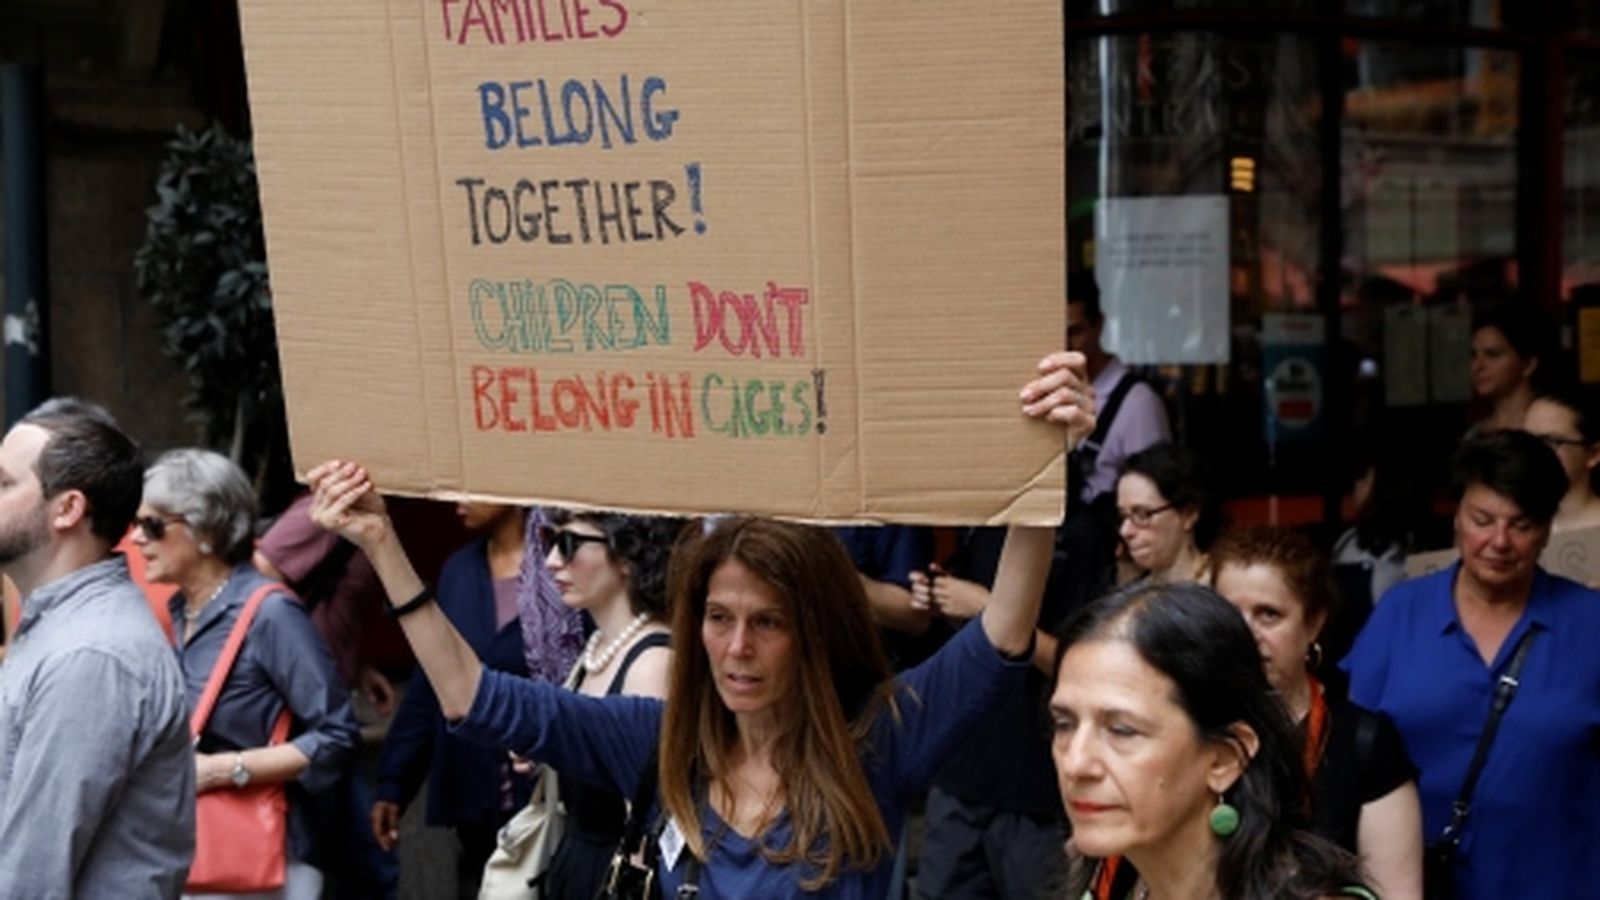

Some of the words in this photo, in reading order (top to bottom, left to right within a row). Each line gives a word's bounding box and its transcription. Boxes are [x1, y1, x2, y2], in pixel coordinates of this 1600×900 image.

[477, 74, 680, 149] BELONG
[455, 161, 707, 246] TOGETHER!
[470, 364, 640, 433] BELONG
[701, 367, 827, 438] CAGES!
